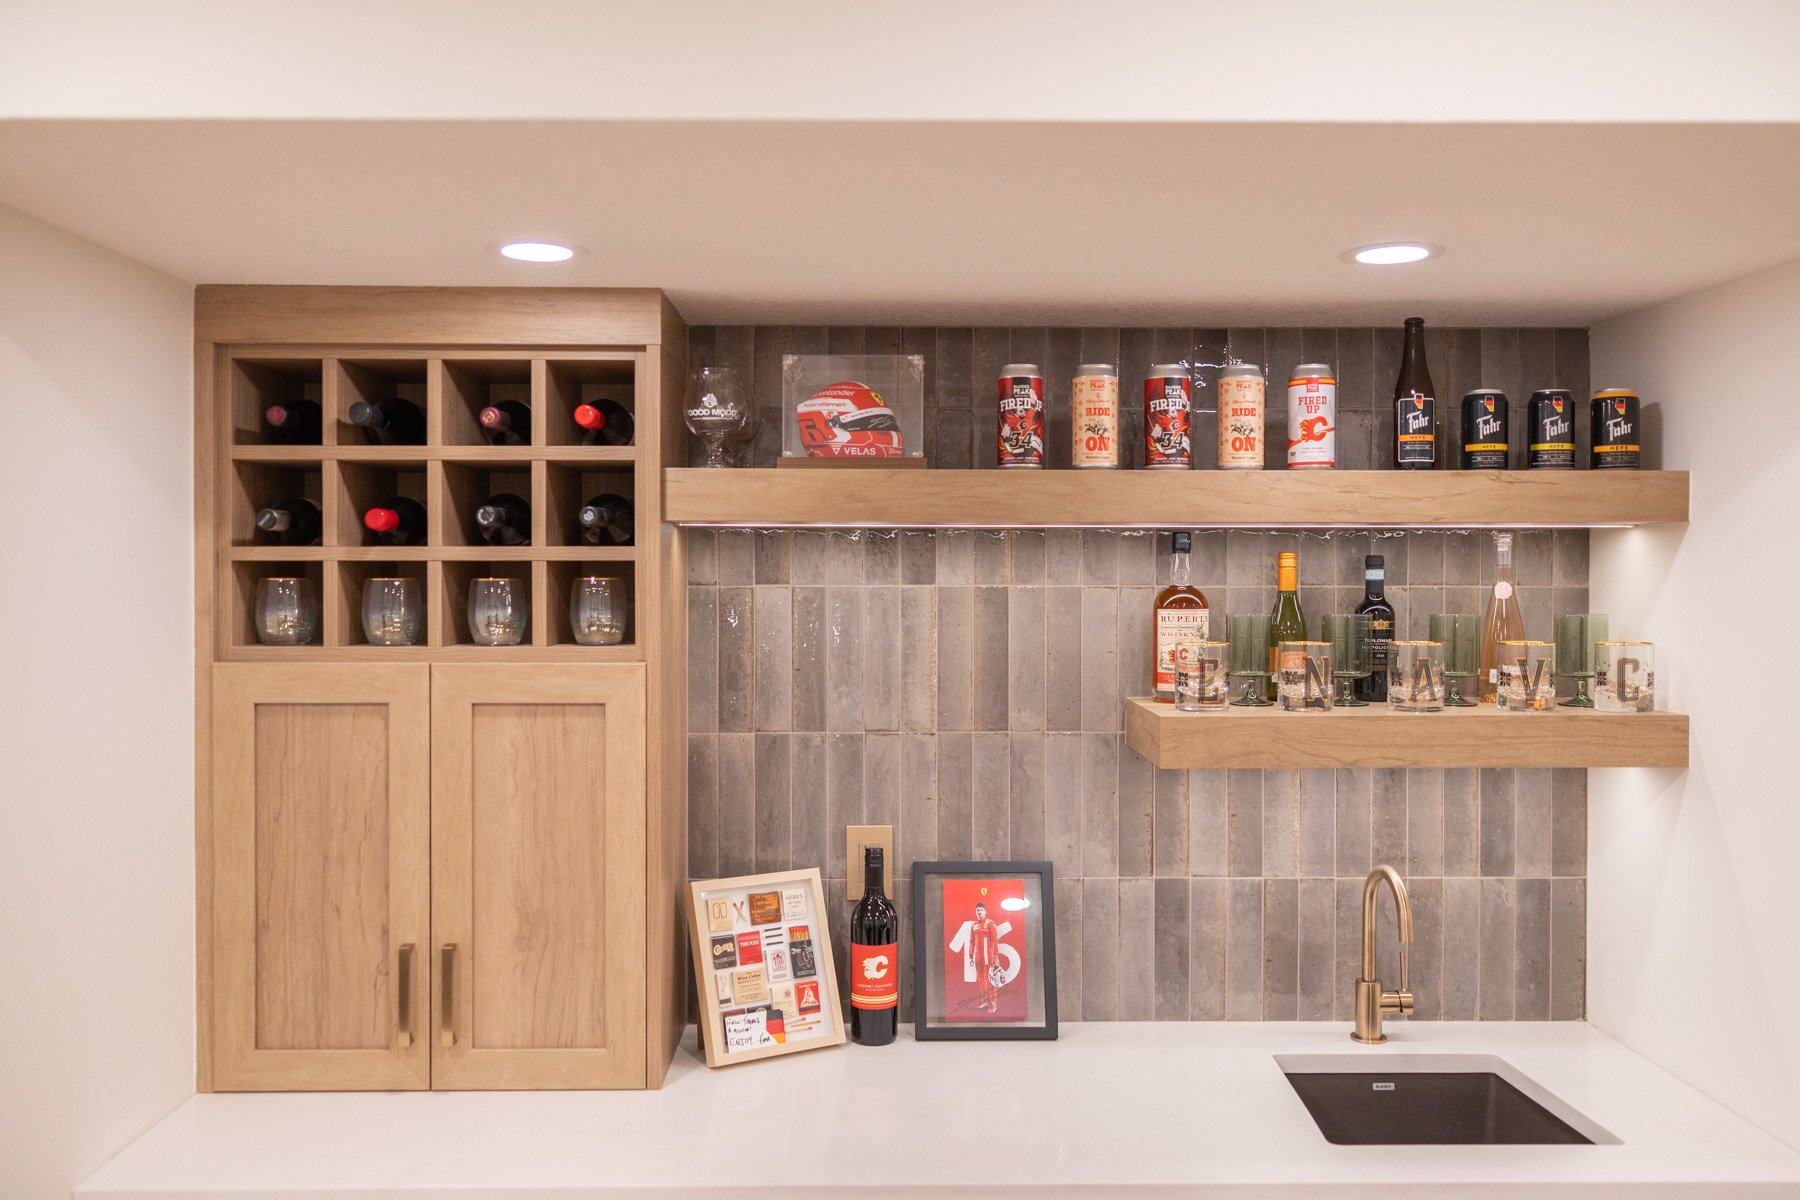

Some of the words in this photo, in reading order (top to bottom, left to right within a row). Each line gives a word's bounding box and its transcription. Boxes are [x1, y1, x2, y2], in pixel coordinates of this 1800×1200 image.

[1013, 388, 1031, 396] PEAK
[1165, 388, 1182, 396] PEAK
[1298, 395, 1328, 406] FIRED
[999, 397, 1031, 412] FIRED
[1085, 407, 1111, 417] RIDE
[1149, 397, 1182, 412] FIRED
[1231, 407, 1257, 417] RIDE
[1306, 405, 1320, 414] UP
[1406, 410, 1430, 434] Fahr
[1476, 414, 1502, 440] Fahr
[1542, 415, 1570, 441] Fahr
[1606, 416, 1633, 442] Fahr
[1008, 430, 1034, 449] 34
[1085, 436, 1111, 452] ON
[1160, 430, 1185, 449] 34
[1231, 436, 1257, 452] ON
[843, 447, 877, 456] VELAS
[1303, 655, 1331, 702] N
[1407, 656, 1438, 704] A
[1514, 656, 1548, 702] V
[1616, 656, 1641, 705] C
[949, 920, 1022, 987] 16
